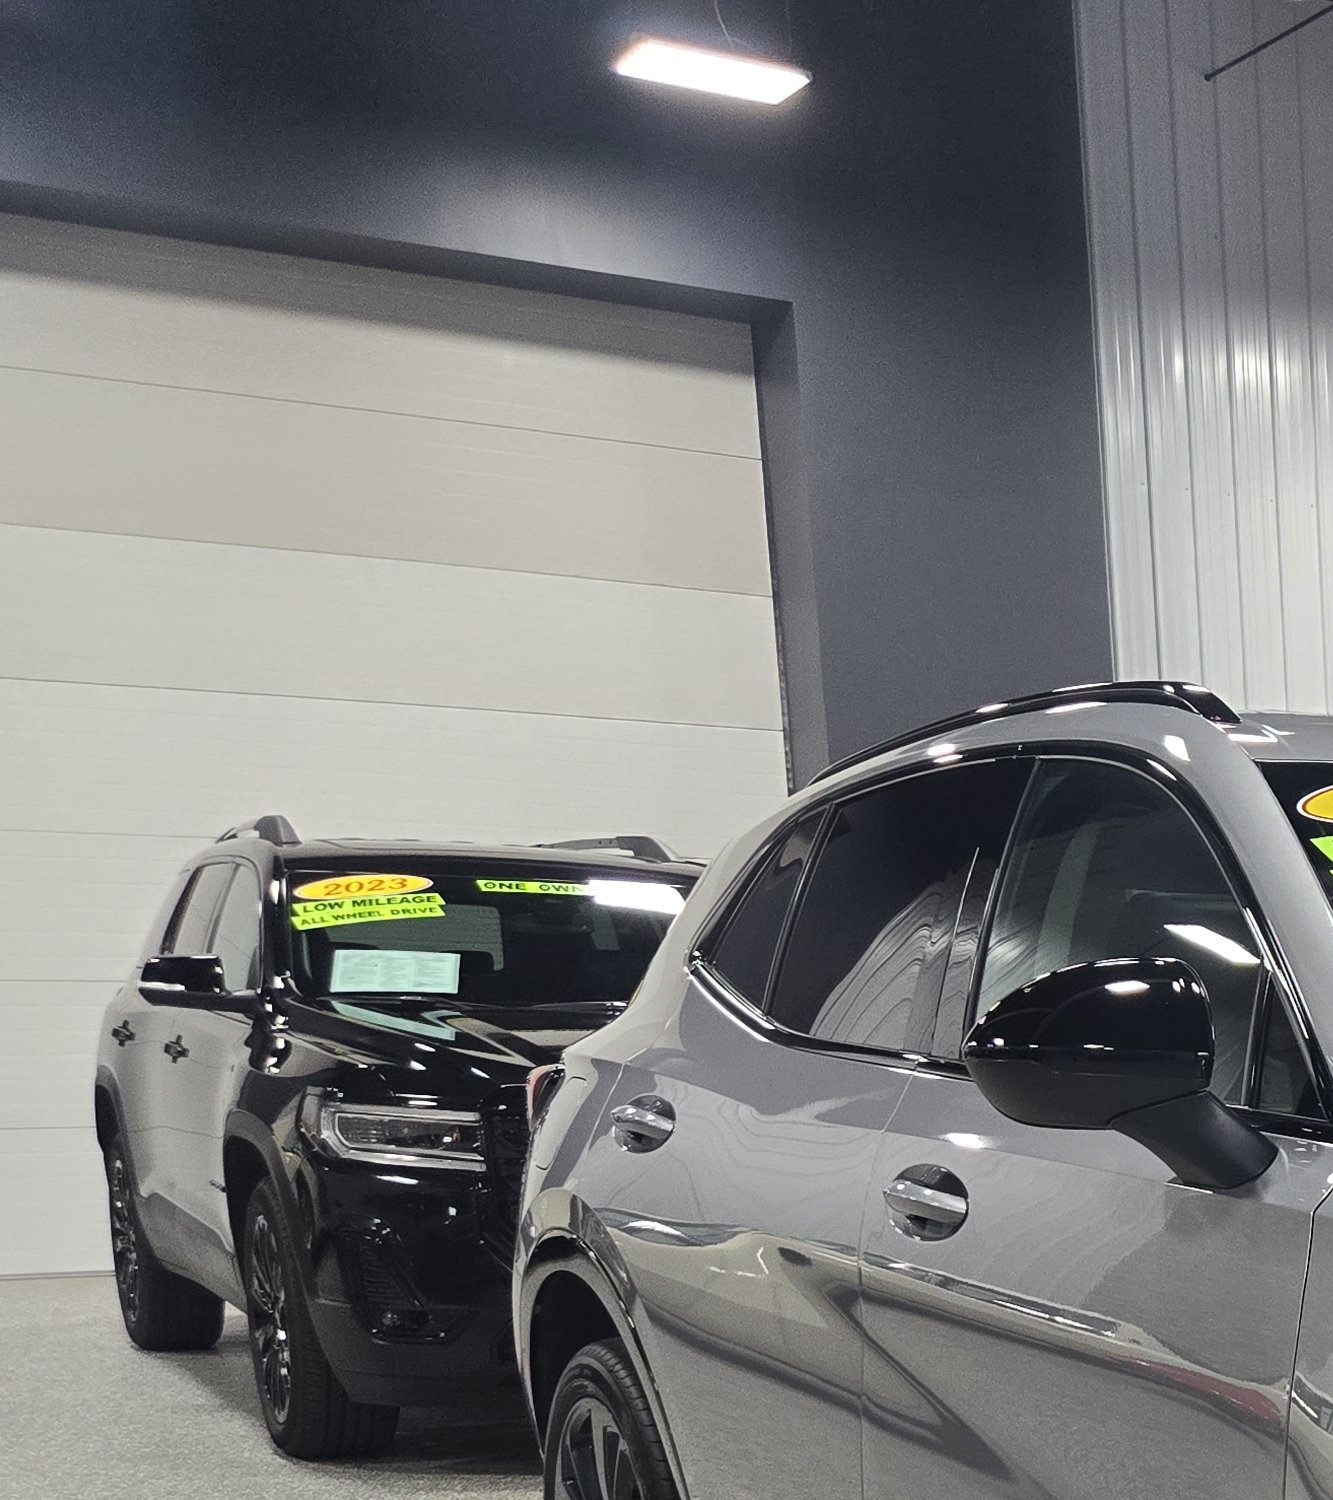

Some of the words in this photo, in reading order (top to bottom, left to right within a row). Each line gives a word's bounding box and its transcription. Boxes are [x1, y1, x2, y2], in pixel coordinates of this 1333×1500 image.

[323, 877, 409, 897] 2023
[484, 881, 527, 891] ONE
[302, 901, 346, 914] LOW
[351, 894, 439, 907] MILEAGE
[300, 915, 329, 927] ALL
[331, 909, 384, 921] WHEEL
[390, 905, 438, 917] DRIVE
